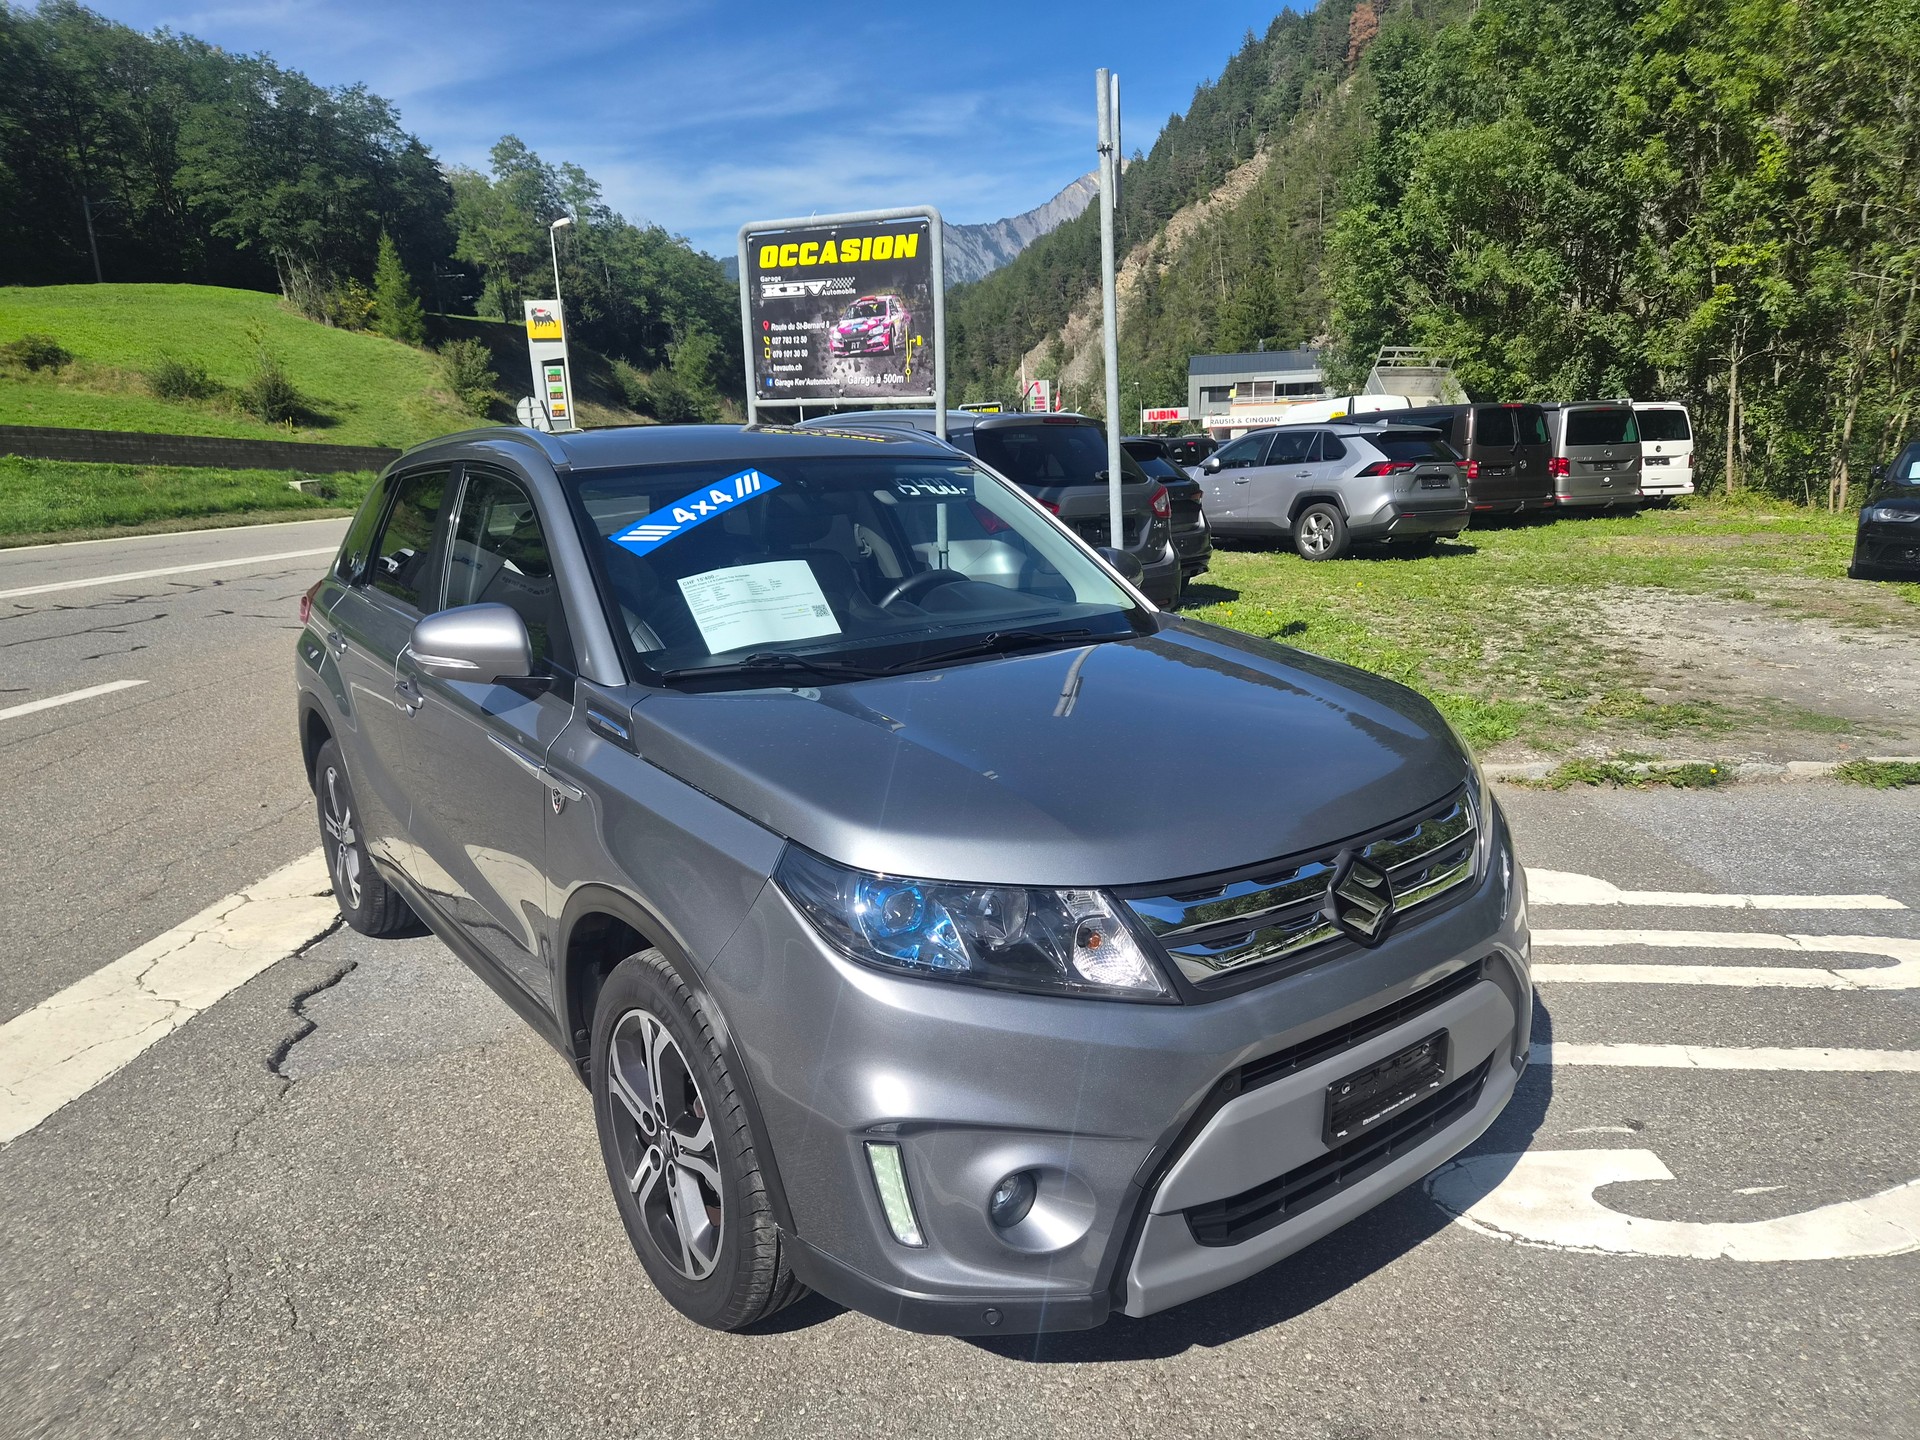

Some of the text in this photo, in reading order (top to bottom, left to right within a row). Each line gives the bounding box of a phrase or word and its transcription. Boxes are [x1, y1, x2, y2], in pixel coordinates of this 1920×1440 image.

[759, 234, 919, 269] OCCASION
[771, 323, 787, 331] Route
[796, 321, 825, 330] St-Bernard
[771, 336, 781, 345] 027
[793, 336, 800, 344] 12
[800, 335, 808, 344] 50
[772, 349, 809, 358] 079 101 30 50
[774, 378, 794, 388] Garage
[847, 373, 904, 387] Garage à 500m
[1148, 410, 1179, 420] JUBIN
[1210, 417, 1235, 425] RAUSIS
[1245, 416, 1283, 424] CINQUAN
[672, 489, 734, 524] 4x4
